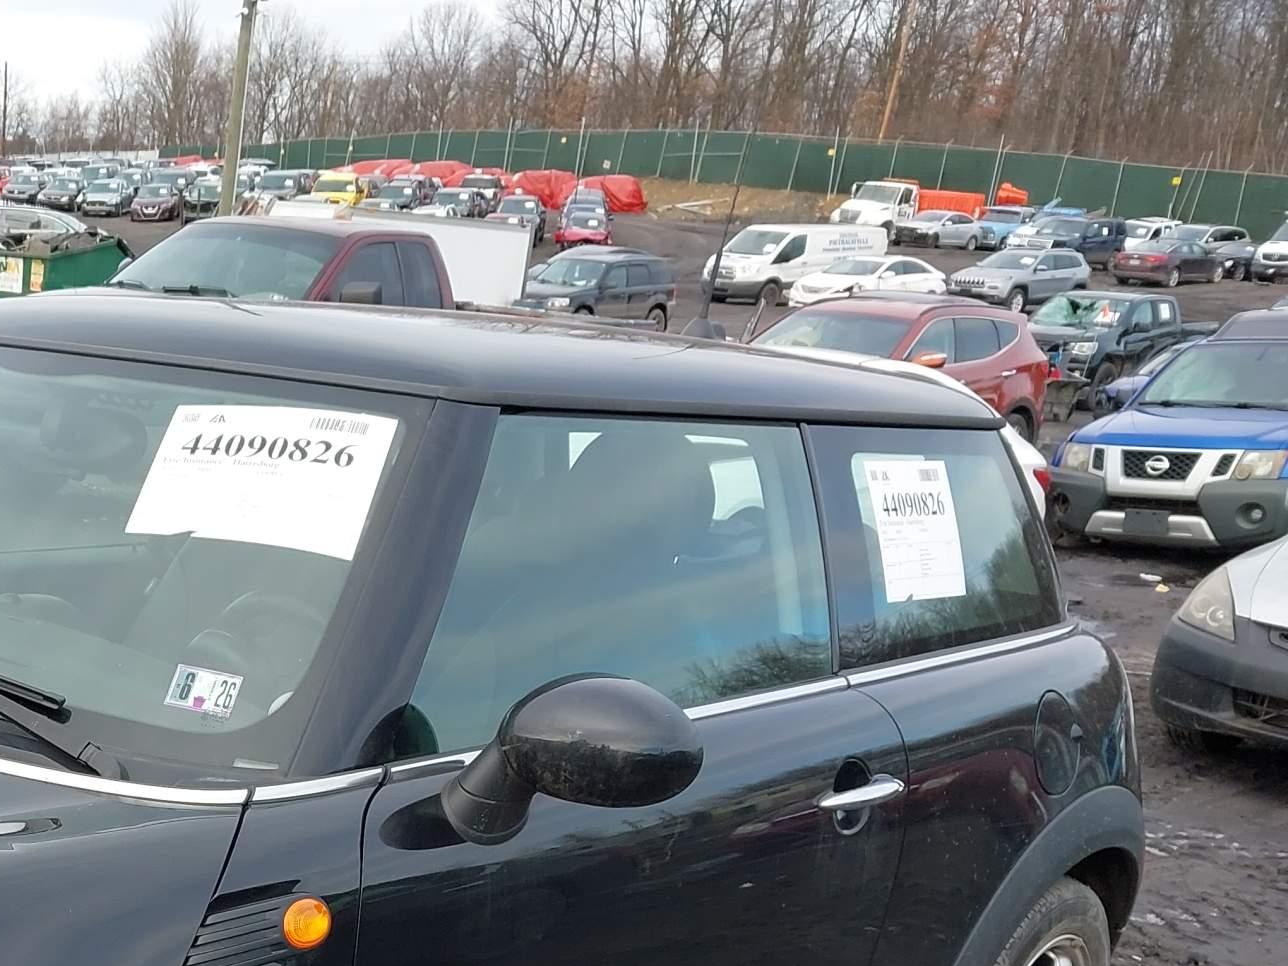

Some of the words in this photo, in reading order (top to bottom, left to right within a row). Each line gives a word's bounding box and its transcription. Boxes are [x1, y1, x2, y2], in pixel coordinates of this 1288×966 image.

[182, 434, 360, 467] 44090826
[882, 491, 945, 517] 44090826
[179, 672, 196, 700] 6
[214, 680, 237, 709] 26
